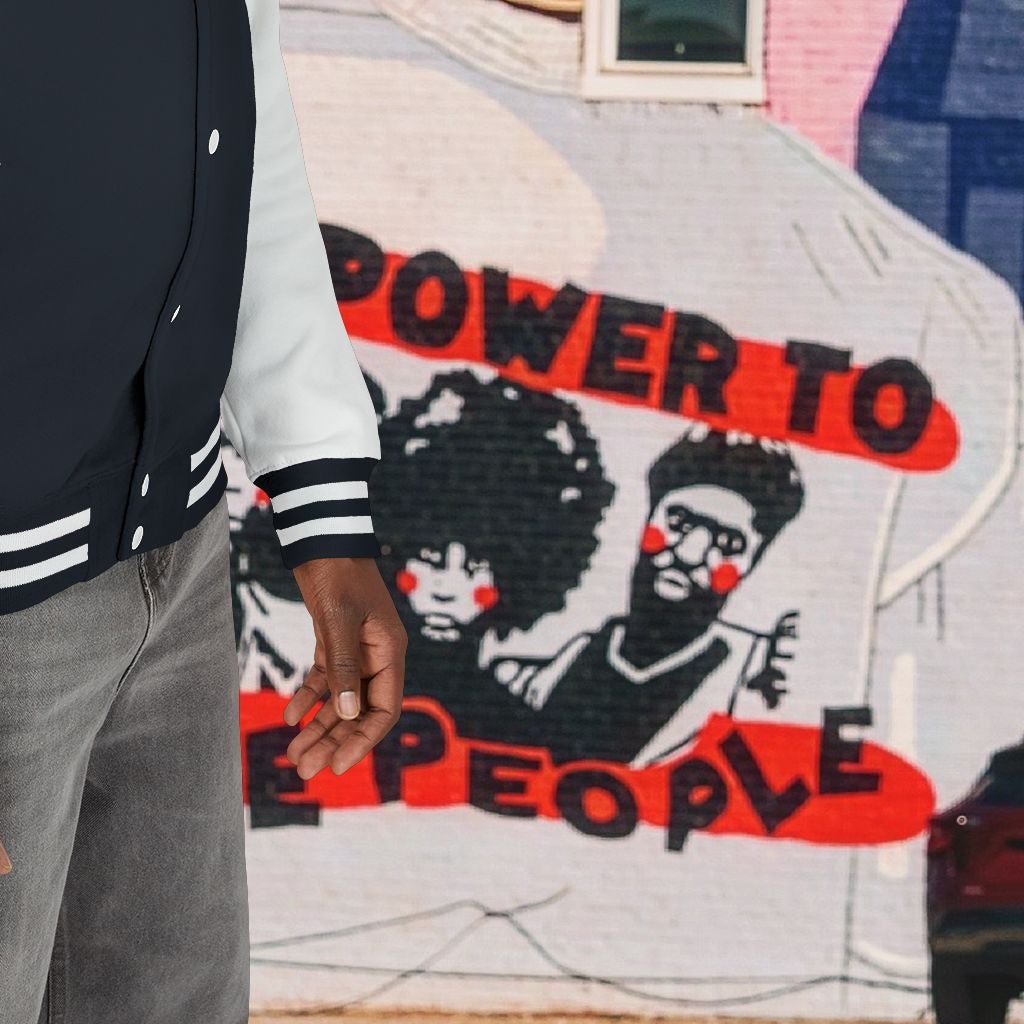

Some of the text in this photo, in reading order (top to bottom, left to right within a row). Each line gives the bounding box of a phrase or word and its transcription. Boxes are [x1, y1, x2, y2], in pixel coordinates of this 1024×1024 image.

[319, 223, 935, 454] POWER TO
[372, 707, 883, 852] PEOPLE
